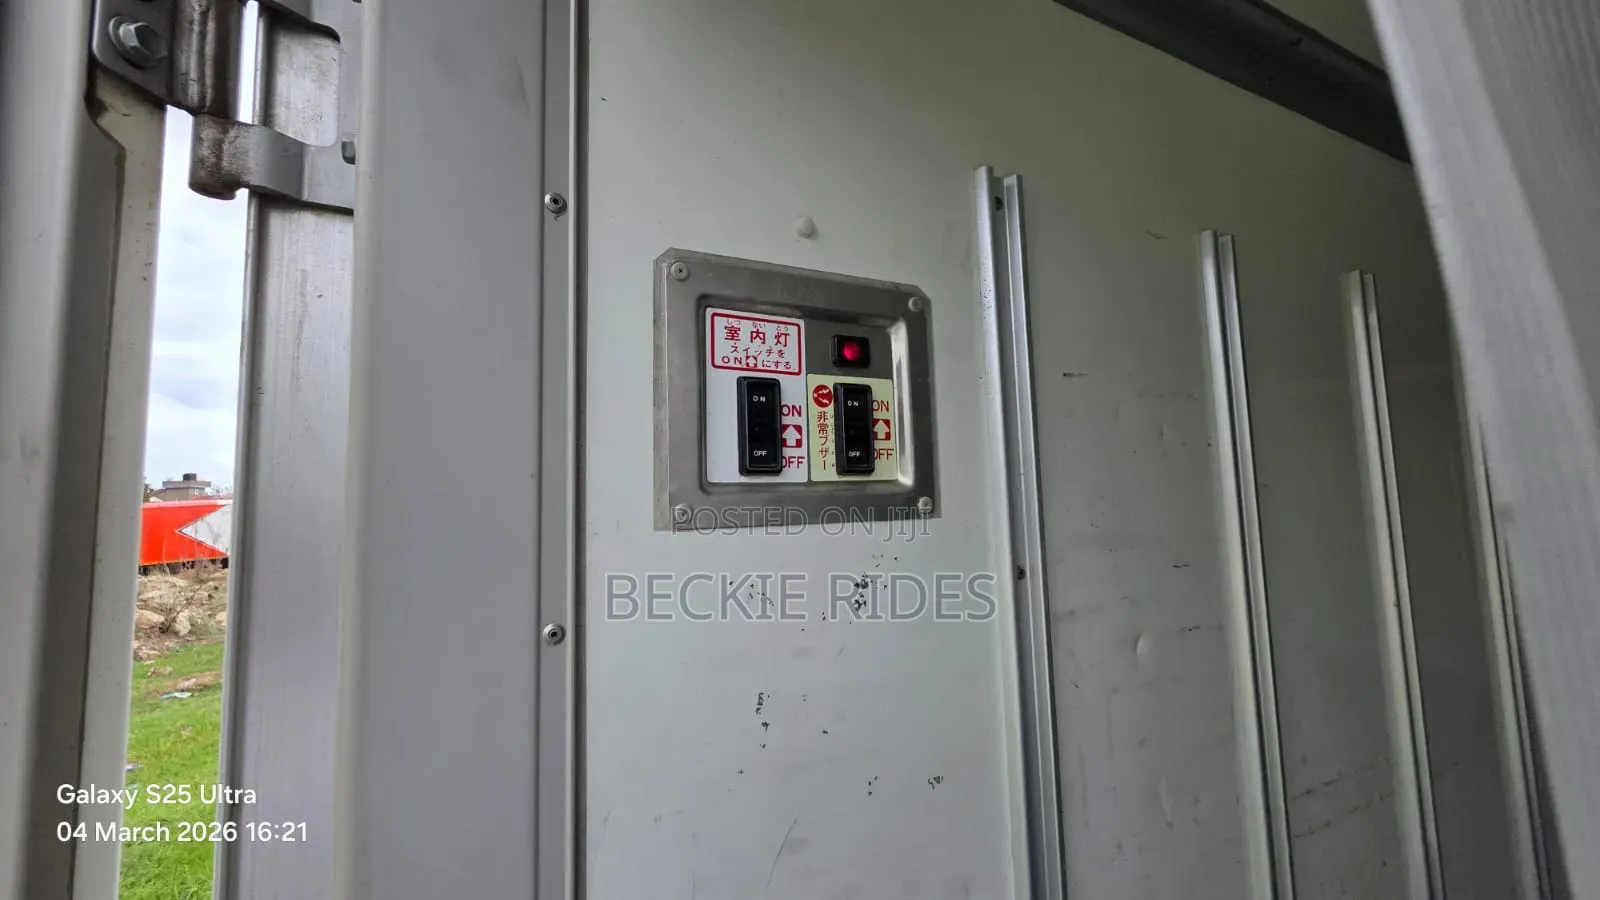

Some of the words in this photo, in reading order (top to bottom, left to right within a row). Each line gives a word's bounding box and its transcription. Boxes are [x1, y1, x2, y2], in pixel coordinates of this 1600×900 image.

[724, 325, 790, 347] 室内灯
[730, 345, 785, 358] スイッチを
[752, 395, 766, 403] ON
[781, 404, 802, 418] ON
[872, 400, 889, 413] ON
[816, 410, 830, 470] 非常ブザー
[753, 449, 768, 457] OFF
